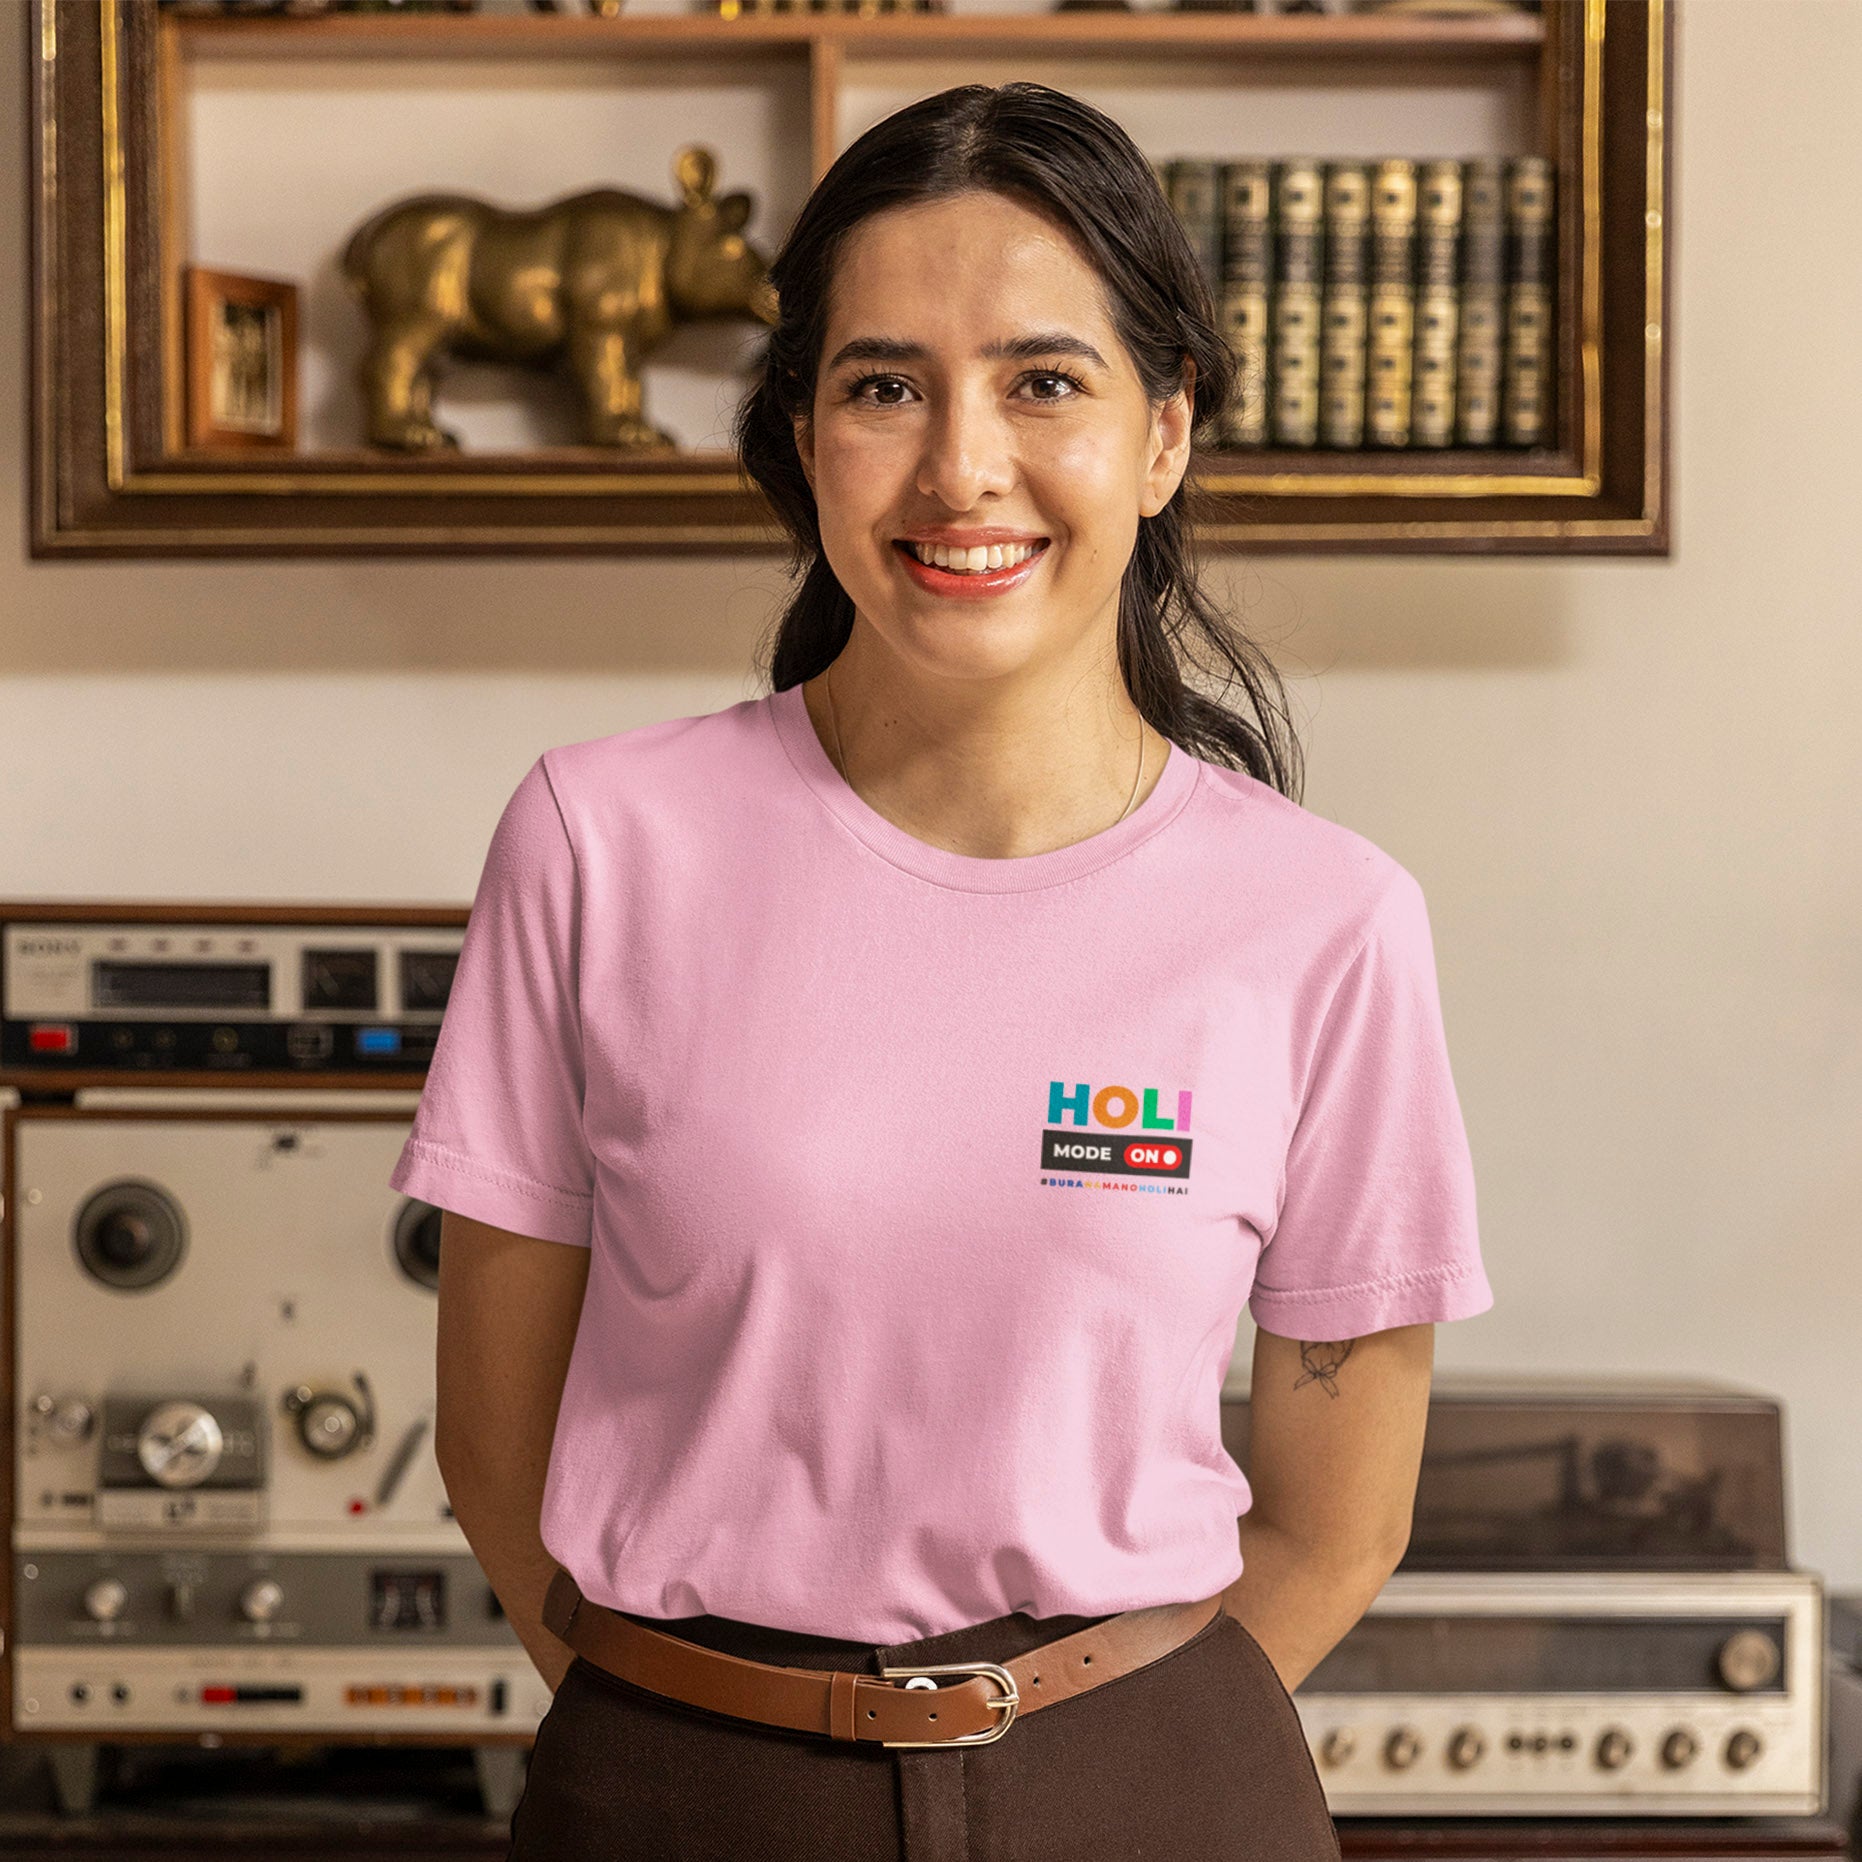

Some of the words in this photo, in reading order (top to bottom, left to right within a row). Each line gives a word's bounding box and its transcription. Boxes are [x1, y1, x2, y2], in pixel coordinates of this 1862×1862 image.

[1048, 1081, 1193, 1132] HOLI
[1053, 1143, 1112, 1161] MODE
[1130, 1148, 1159, 1164] ON
